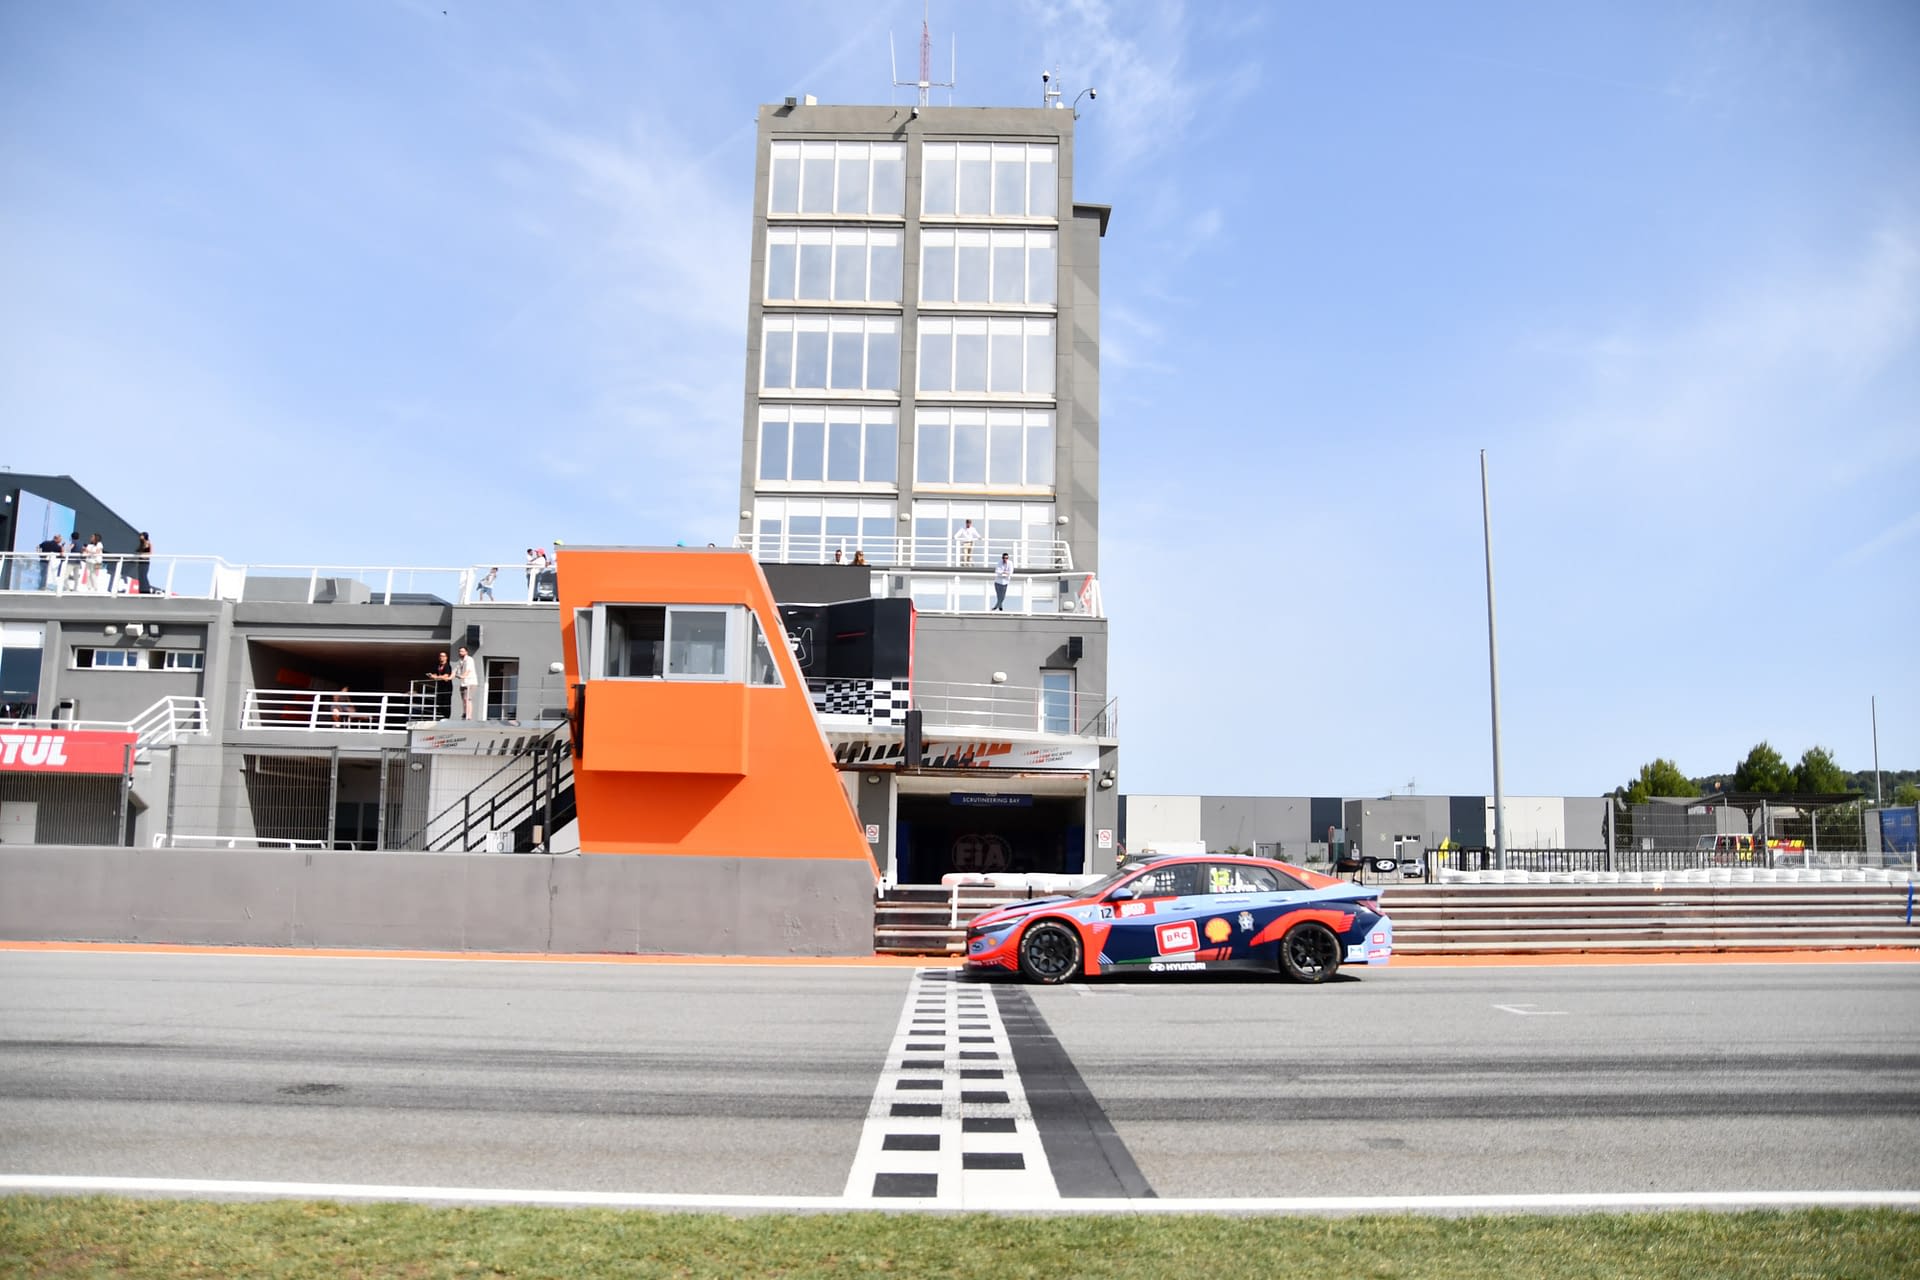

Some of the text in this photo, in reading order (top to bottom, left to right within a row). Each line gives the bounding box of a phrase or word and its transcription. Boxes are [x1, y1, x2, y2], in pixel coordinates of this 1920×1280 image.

[0, 734, 68, 766] TUL
[1100, 907, 1113, 919] 12
[1166, 931, 1188, 942] BRC
[1165, 962, 1206, 971] HYUNDAI
